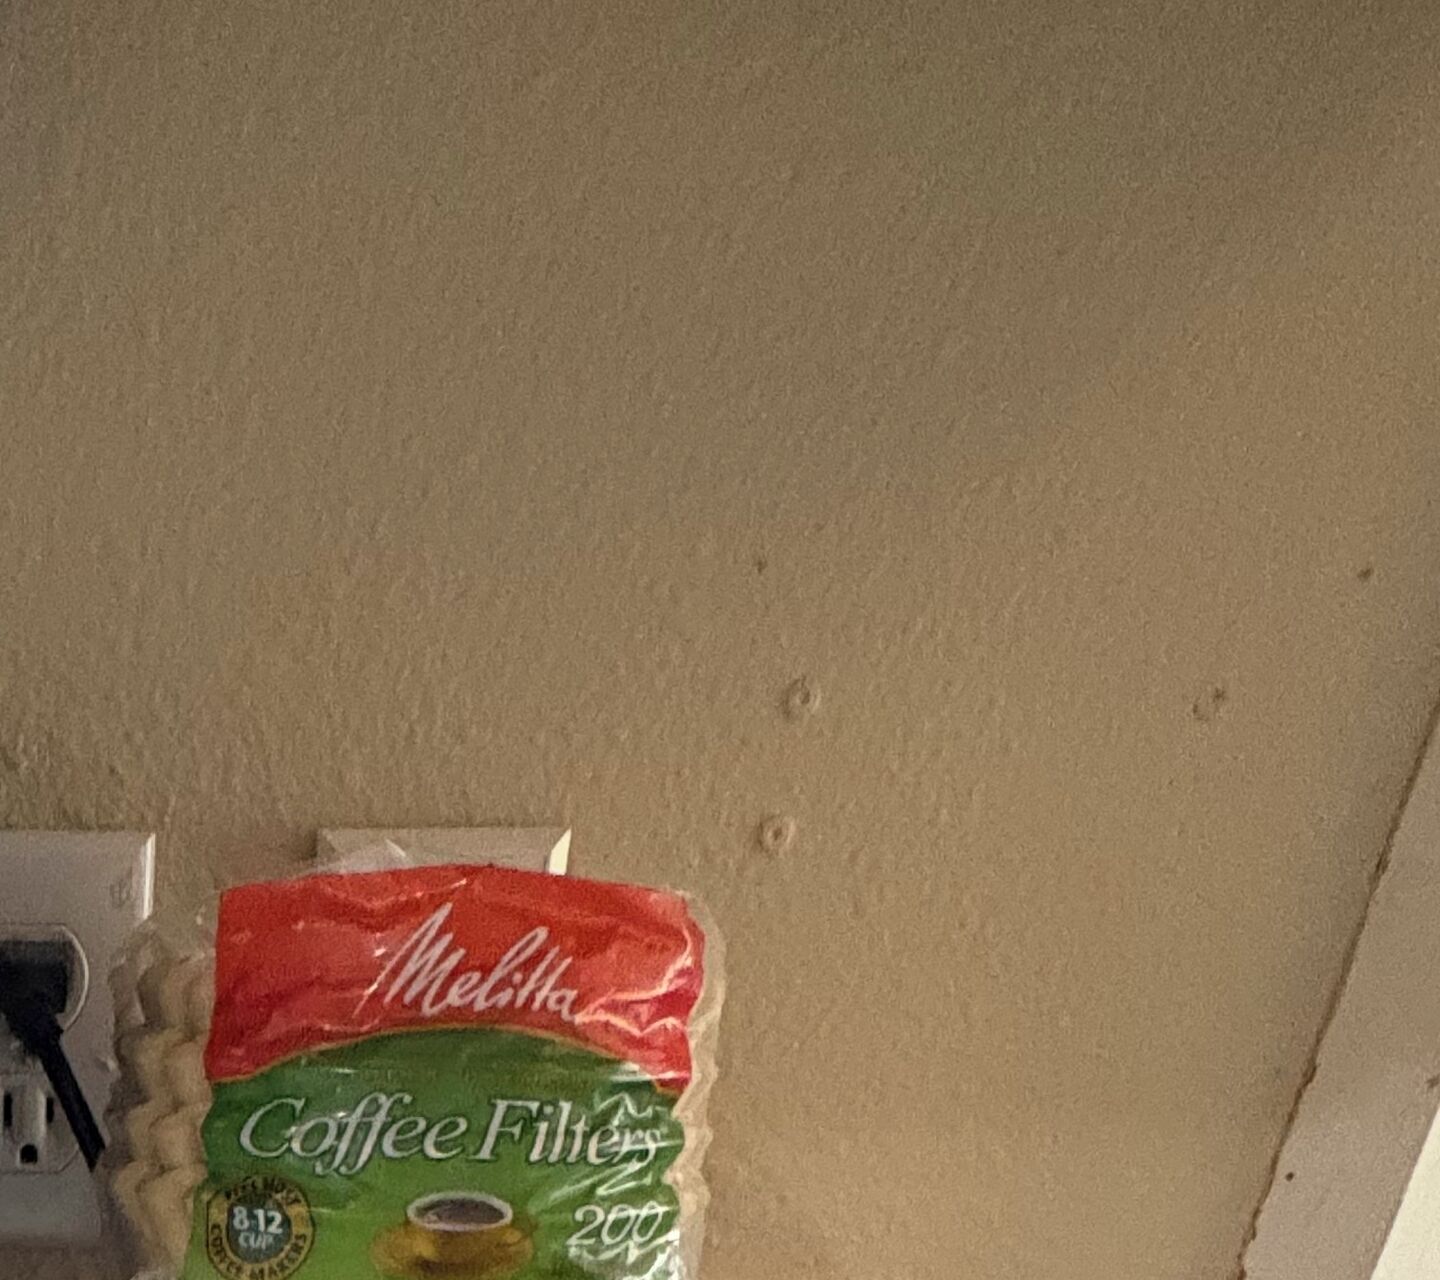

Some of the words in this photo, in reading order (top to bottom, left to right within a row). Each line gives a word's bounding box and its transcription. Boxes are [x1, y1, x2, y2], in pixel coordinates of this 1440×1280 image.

[352, 901, 581, 1022] Melitta
[239, 1091, 469, 1176] Coffee
[466, 1097, 662, 1167] Filters
[566, 1201, 663, 1246] 200
